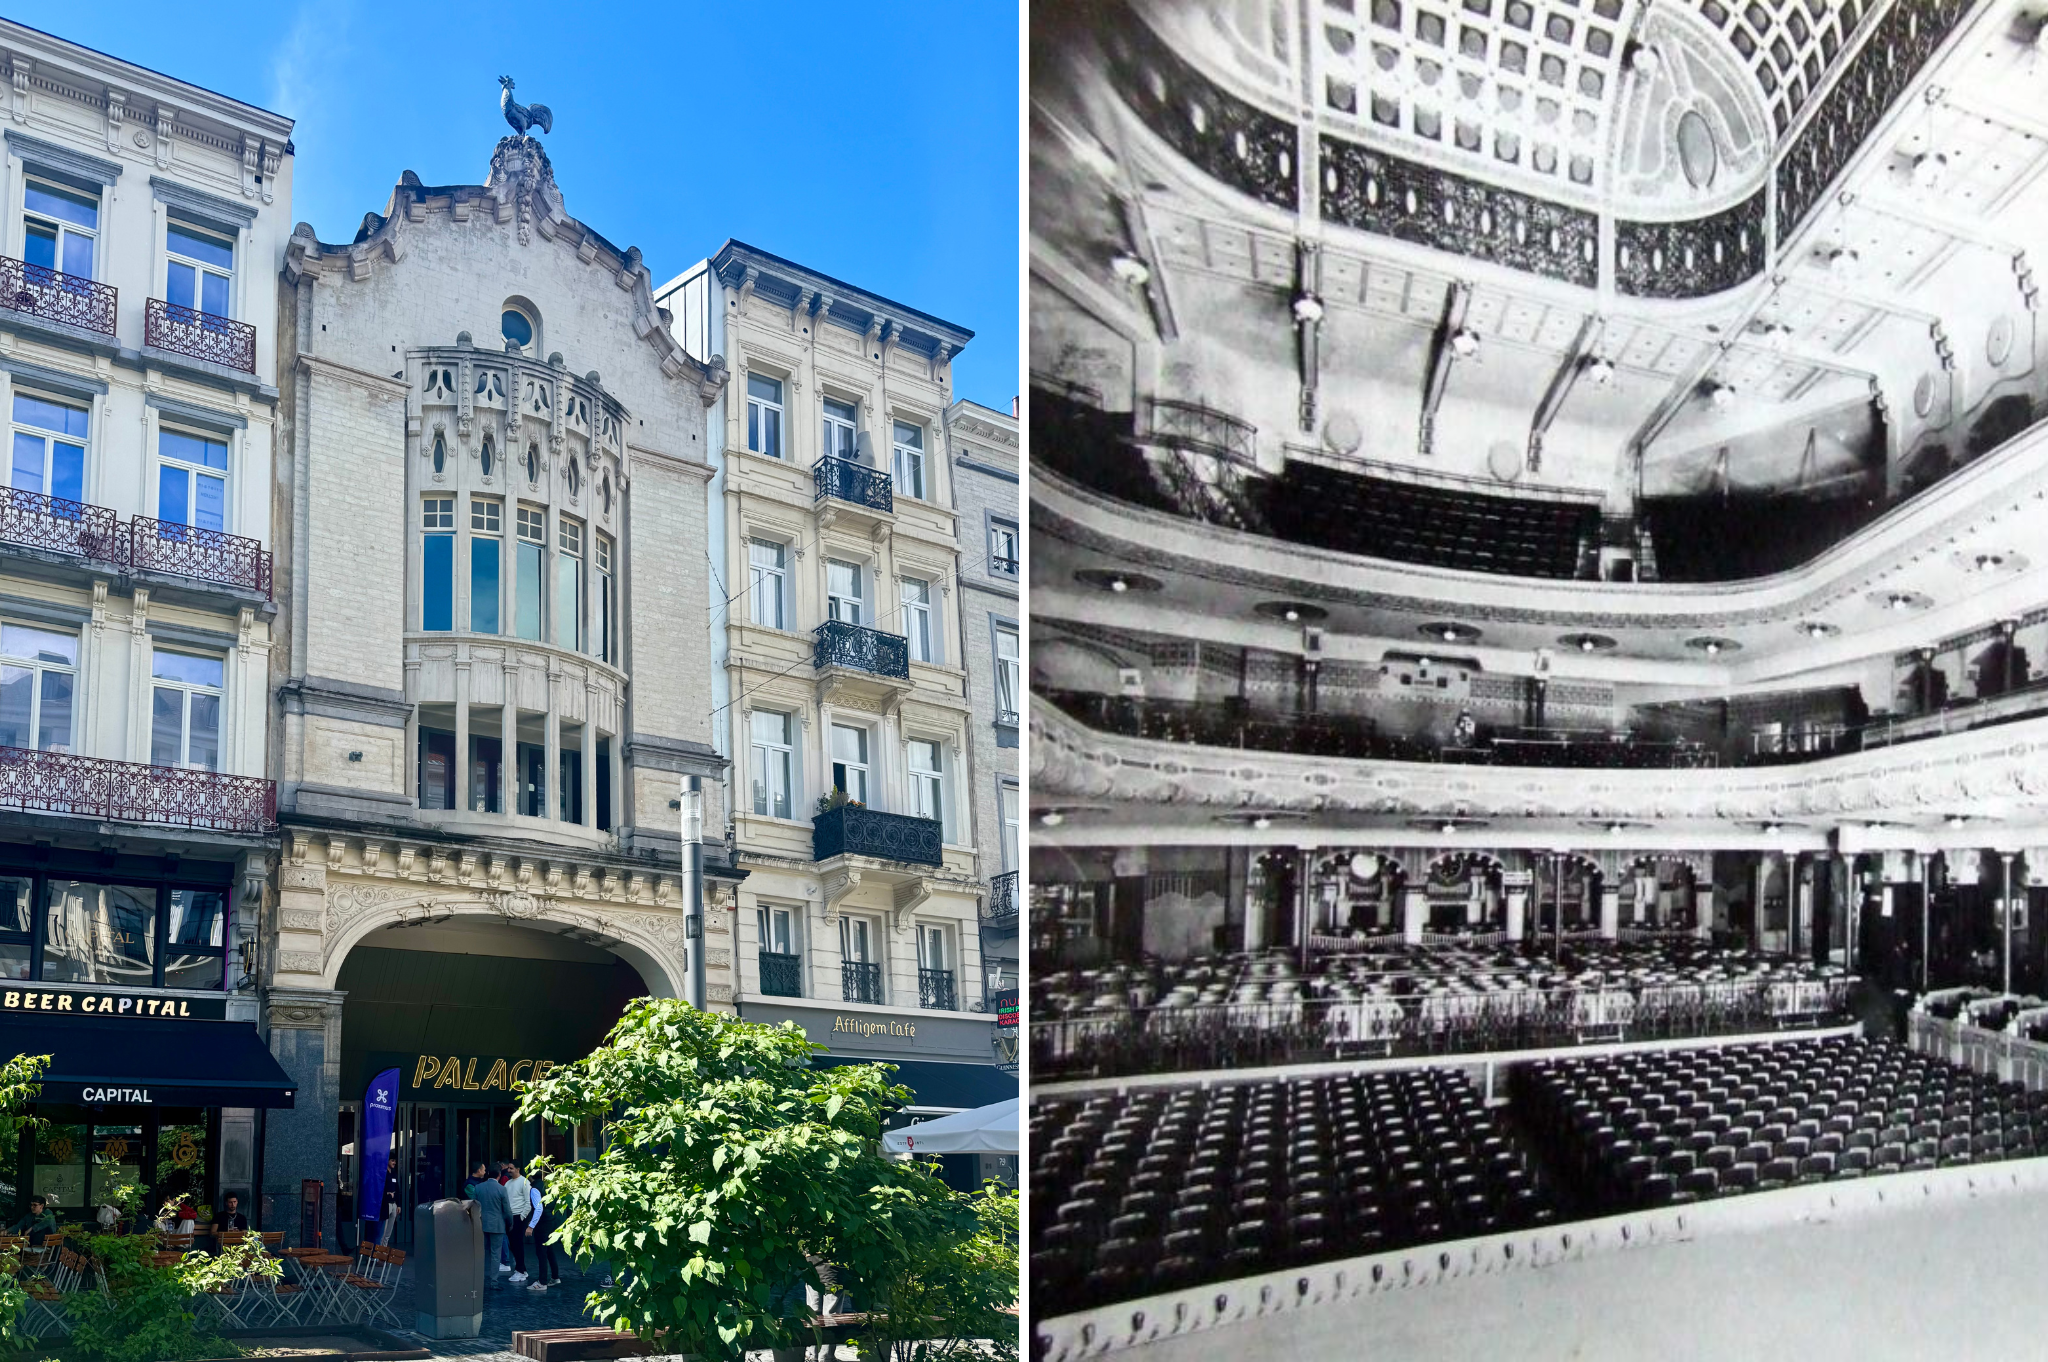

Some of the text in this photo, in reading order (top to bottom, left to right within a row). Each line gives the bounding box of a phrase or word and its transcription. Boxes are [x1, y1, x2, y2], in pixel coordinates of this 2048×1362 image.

[4, 991, 191, 1017] BEER CAPITAL
[998, 1006, 1015, 1014] IRISH
[832, 1015, 916, 1038] Affligem Café
[412, 1055, 555, 1092] PALACE
[82, 1087, 153, 1103] CAPITAL
